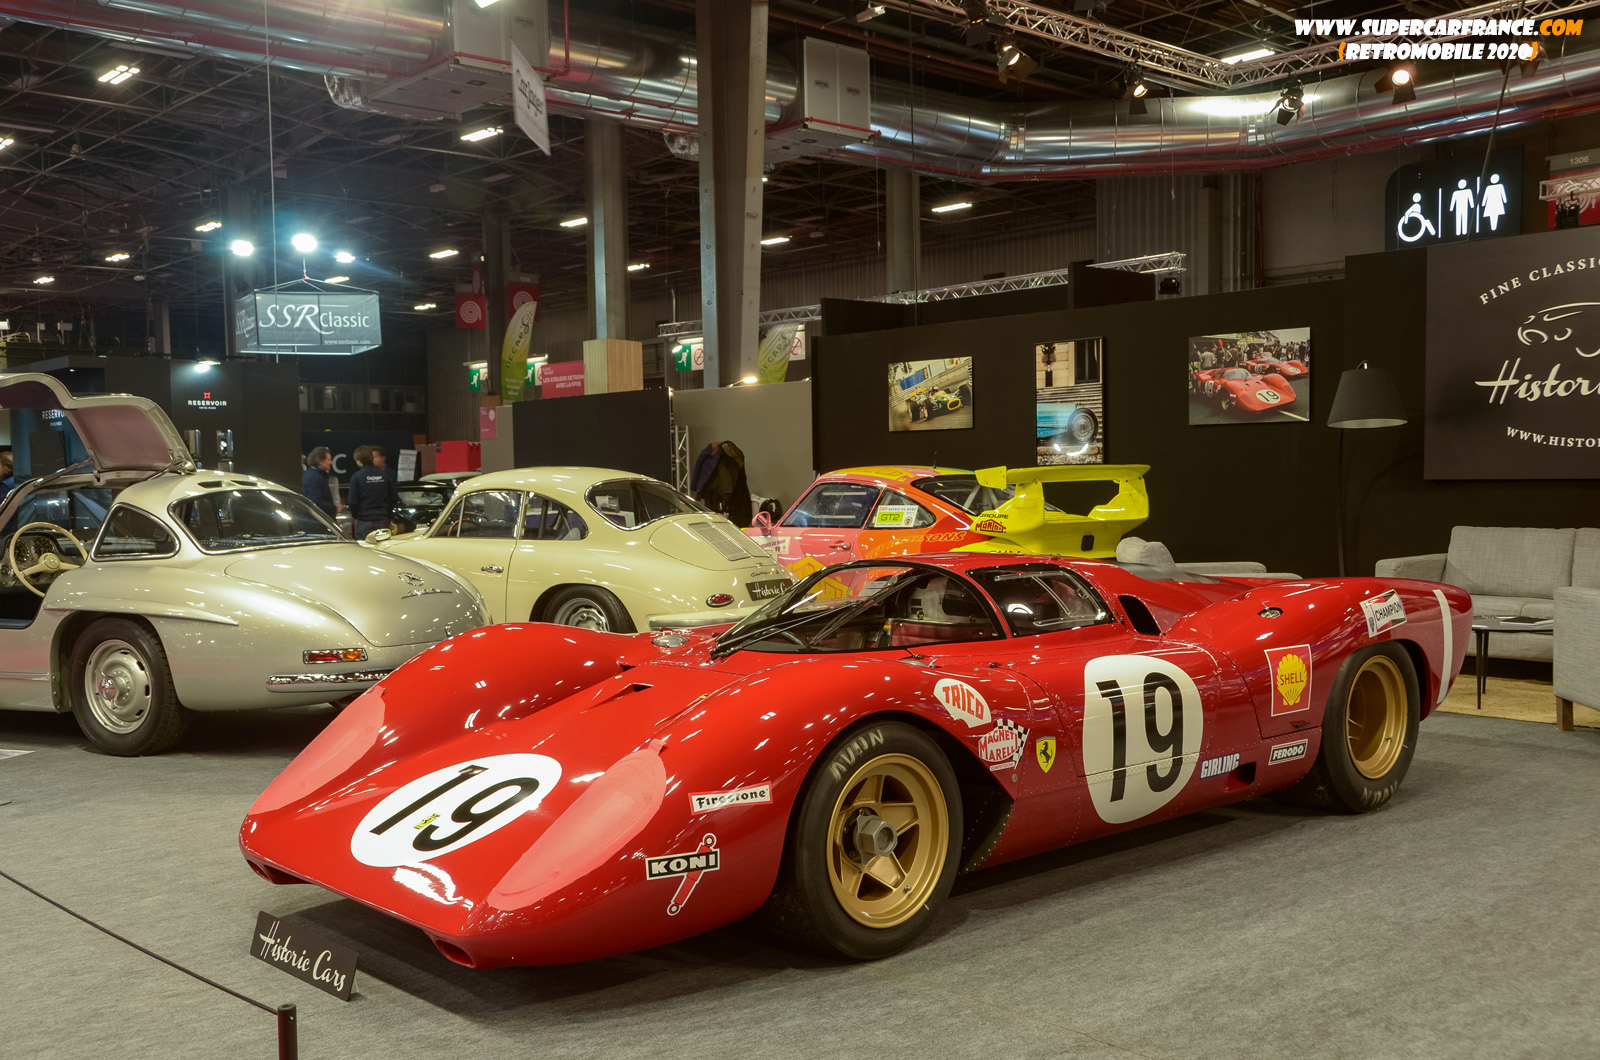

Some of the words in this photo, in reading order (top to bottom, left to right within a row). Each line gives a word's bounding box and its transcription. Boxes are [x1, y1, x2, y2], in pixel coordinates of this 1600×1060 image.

[1569, 156, 1589, 165] 1306
[1480, 277, 1522, 305] FINE
[1529, 257, 1600, 282] CLASSI
[320, 311, 370, 328] Classic
[1506, 426, 1600, 448] WWW.HISTO
[881, 513, 900, 521] GT2
[752, 581, 780, 599] Historic
[1375, 602, 1403, 621] CHAMPION
[1280, 671, 1304, 686] SHELL
[942, 683, 985, 721] TRICO
[1096, 672, 1184, 803] 19
[830, 728, 885, 783] AVON
[1272, 744, 1305, 760] FERODO
[1201, 753, 1240, 779] GIRLING
[369, 764, 540, 852] 19
[696, 789, 766, 808] Firestone
[651, 853, 716, 875] KONI
[259, 920, 311, 972] Historic
[312, 950, 346, 991] Cars
